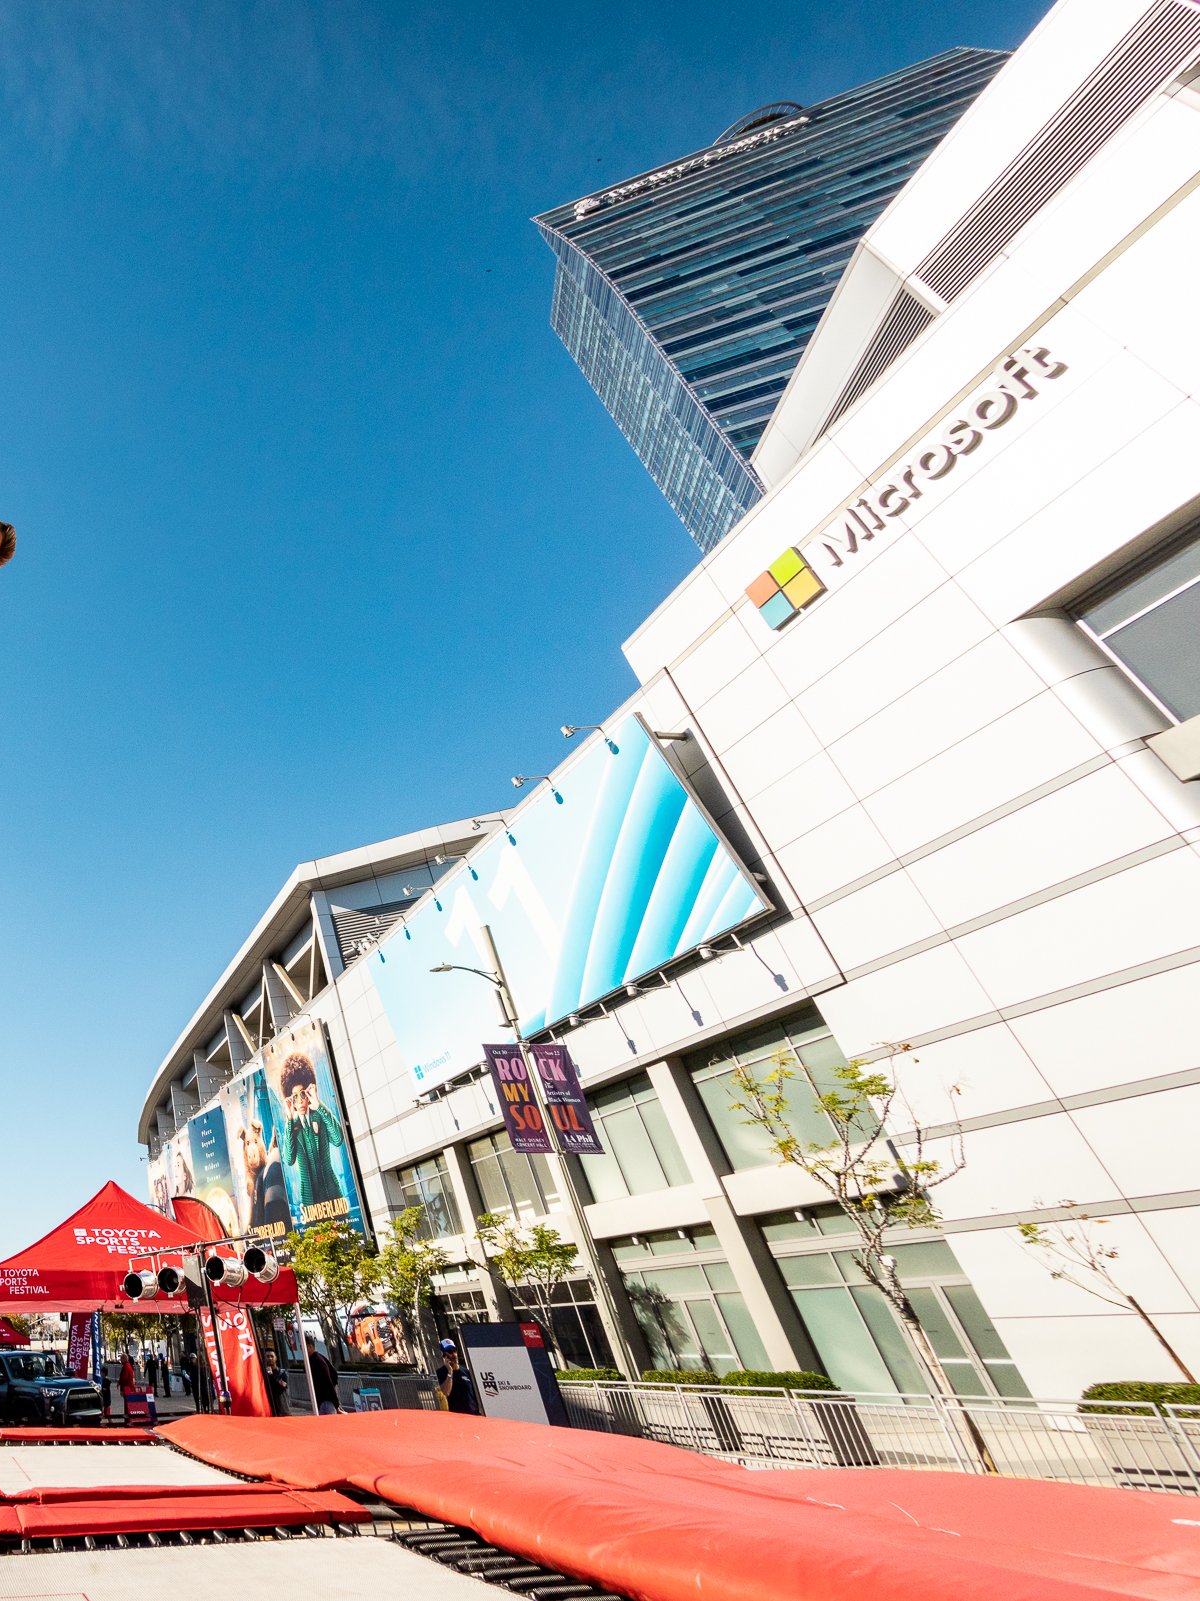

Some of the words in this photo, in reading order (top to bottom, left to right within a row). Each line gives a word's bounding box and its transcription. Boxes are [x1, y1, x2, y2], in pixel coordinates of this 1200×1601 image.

[811, 347, 1068, 567] Microsoft
[501, 1082, 530, 1102] MY
[90, 1228, 162, 1239] TOYOTA
[76, 1237, 140, 1246] SPORTS
[3, 1269, 40, 1277] TOYOTA
[9, 1286, 50, 1295] FESTIVAL
[480, 1372, 495, 1381] US
